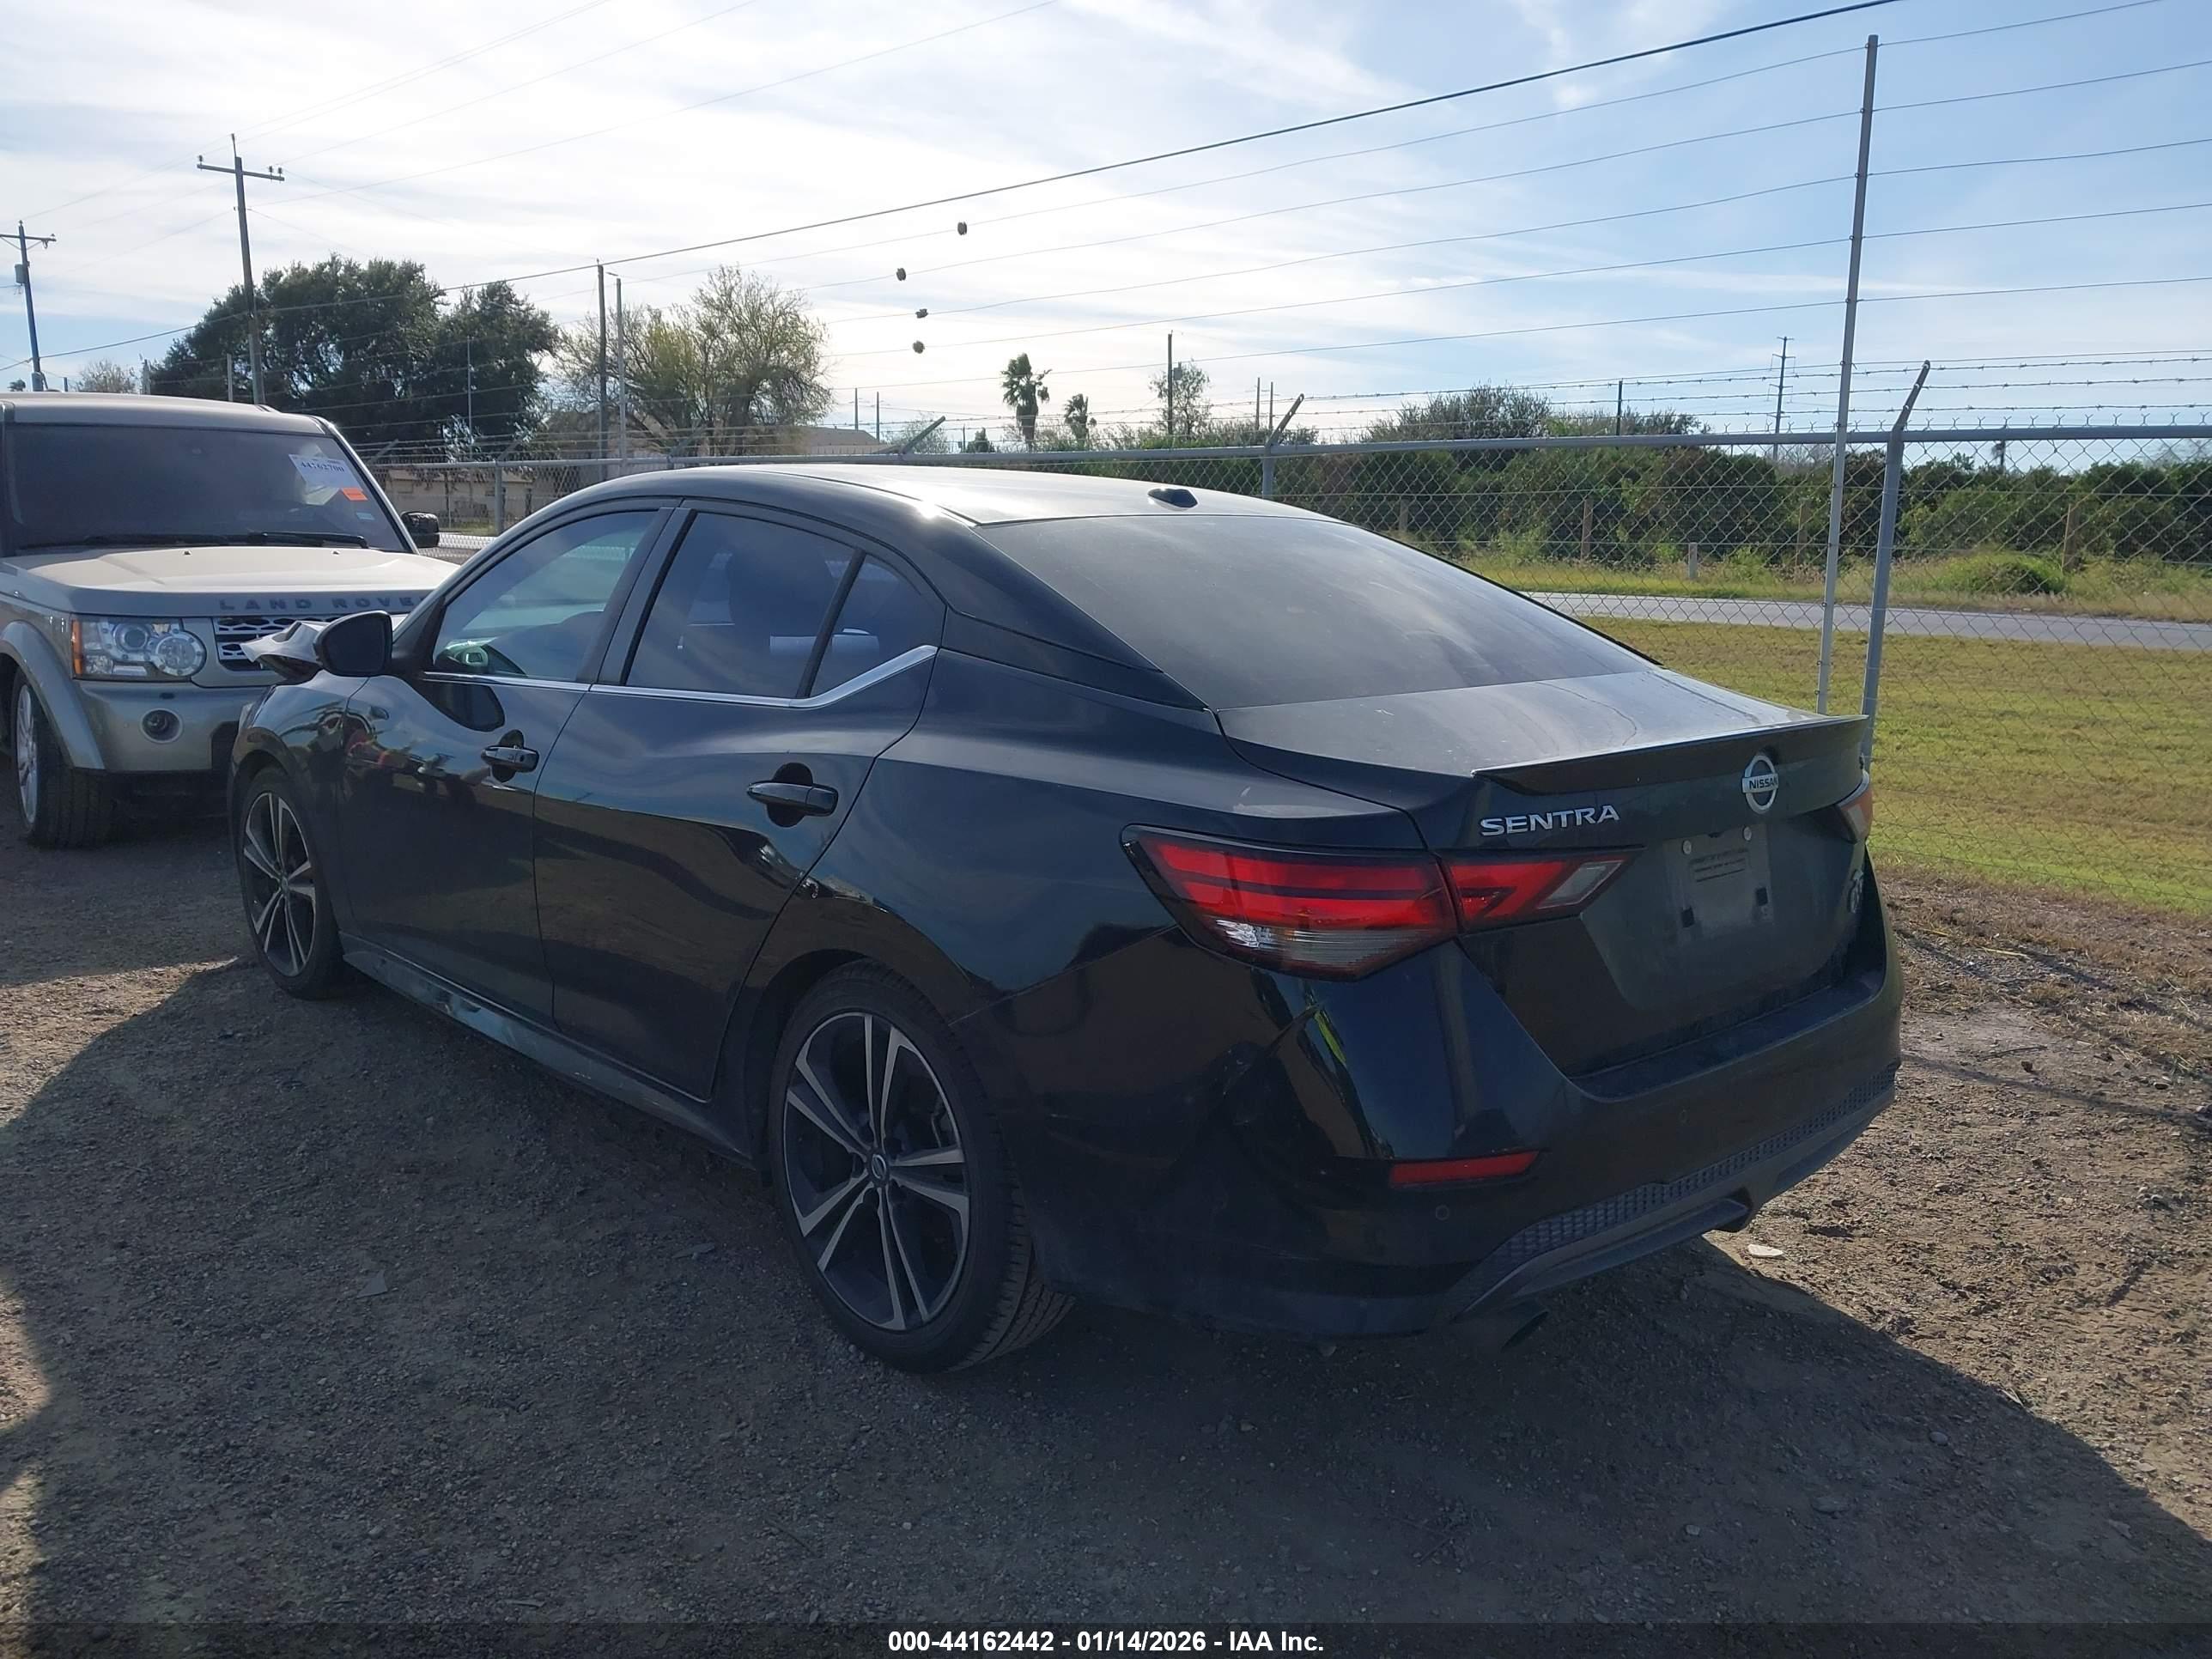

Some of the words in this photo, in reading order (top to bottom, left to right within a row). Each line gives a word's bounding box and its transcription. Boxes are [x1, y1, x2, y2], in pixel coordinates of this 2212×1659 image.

[219, 599, 313, 611] LAND
[332, 597, 426, 609] ROVE
[1748, 776, 1778, 790] NISSAN
[1480, 805, 1620, 836] SENTRA
